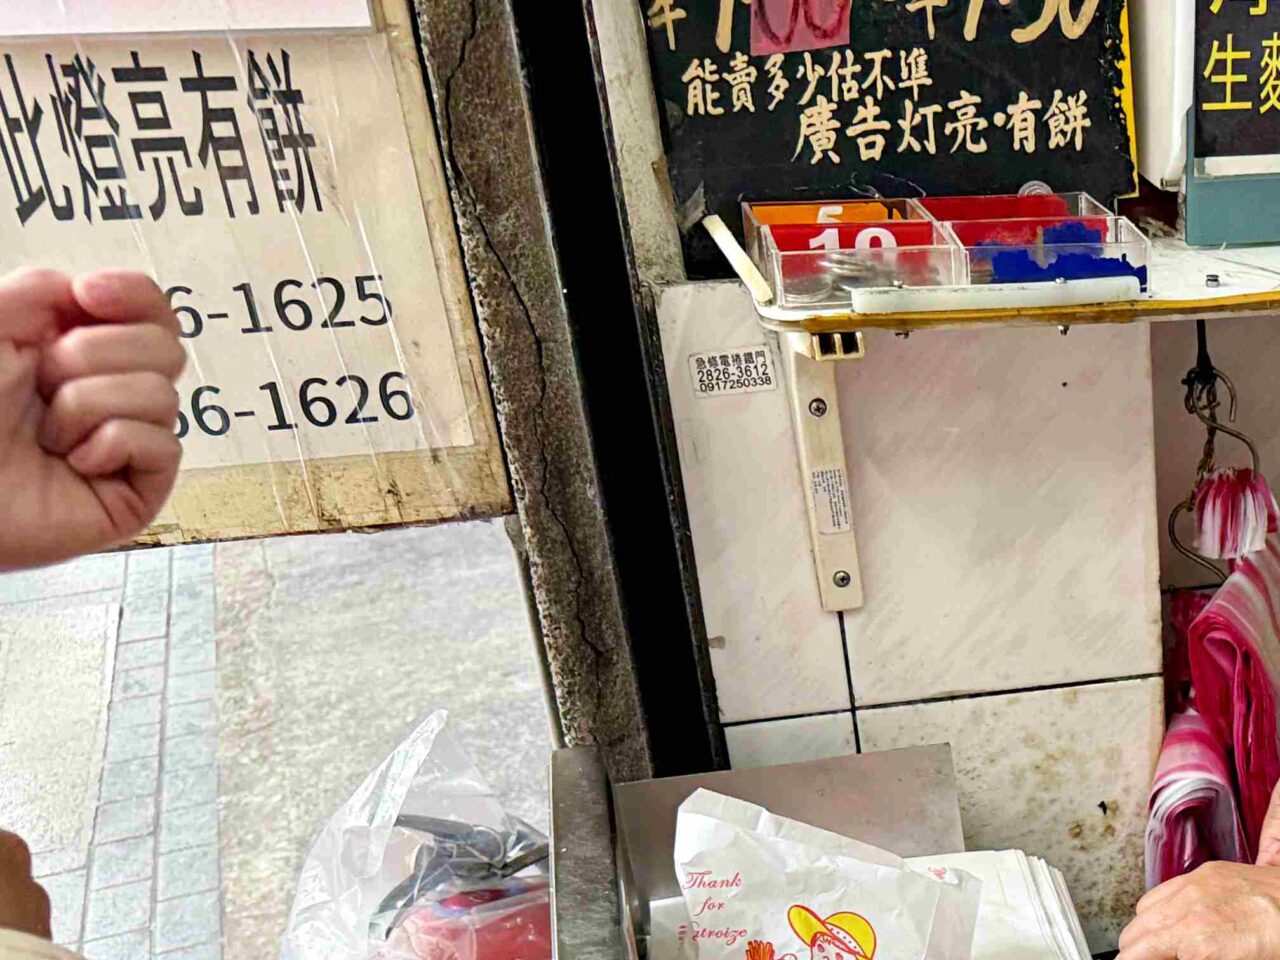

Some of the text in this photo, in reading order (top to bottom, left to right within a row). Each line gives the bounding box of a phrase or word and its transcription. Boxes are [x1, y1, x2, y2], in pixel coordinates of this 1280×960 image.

[681, 48, 933, 116] 能賣多少估不準
[0, 49, 323, 227] 此燈亮有餅
[697, 363, 769, 383] 2826-3612
[700, 376, 772, 392] 0917250338
[682, 870, 742, 890] Thank
[693, 896, 725, 917] for
